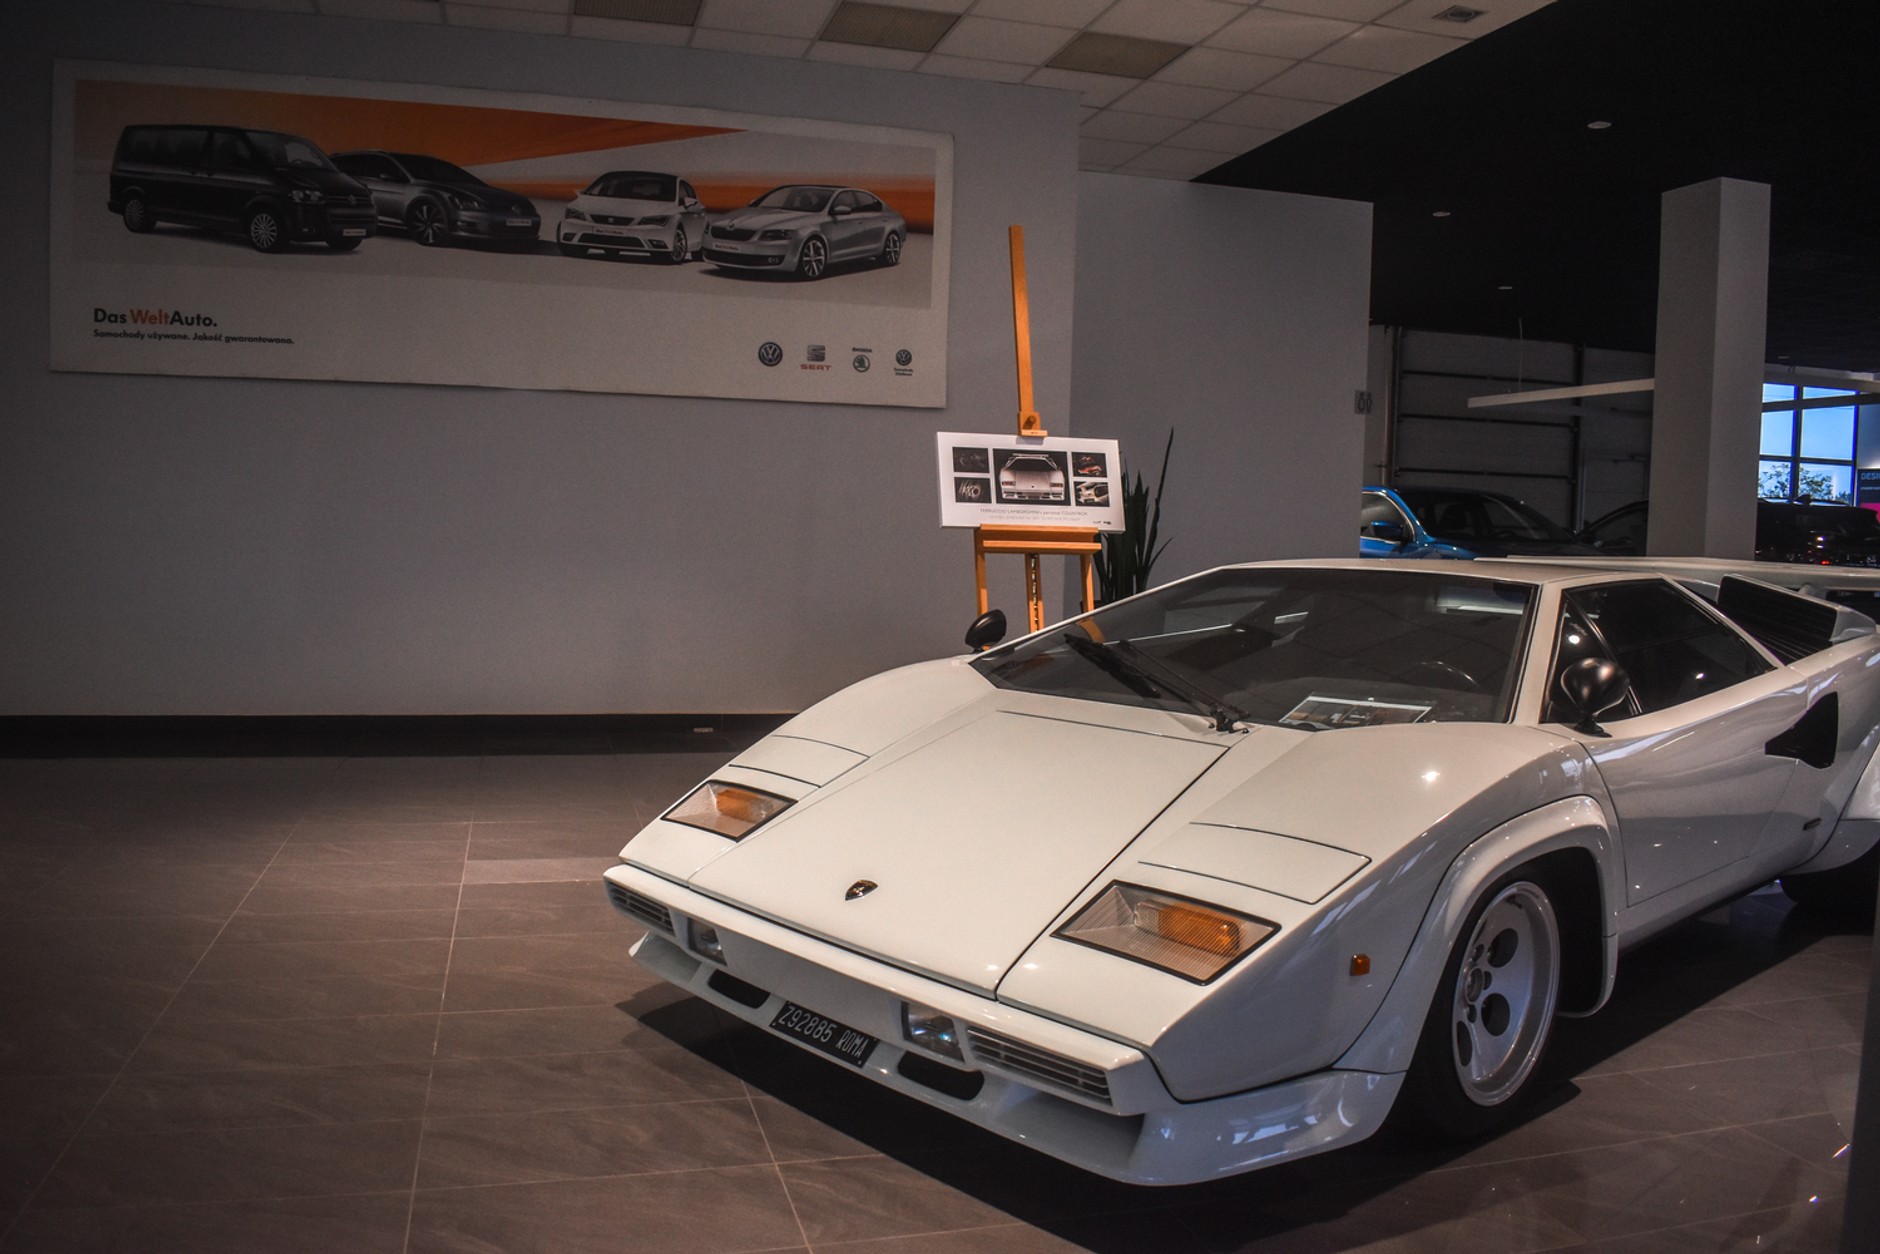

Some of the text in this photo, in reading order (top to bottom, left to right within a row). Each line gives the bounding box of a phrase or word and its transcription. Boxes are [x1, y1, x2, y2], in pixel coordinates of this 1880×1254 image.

[93, 308, 218, 327] Das WeltAuto.
[93, 328, 295, 345] Samochody używane. Jakość gwarantowana.
[835, 1029, 869, 1058] ROMA
